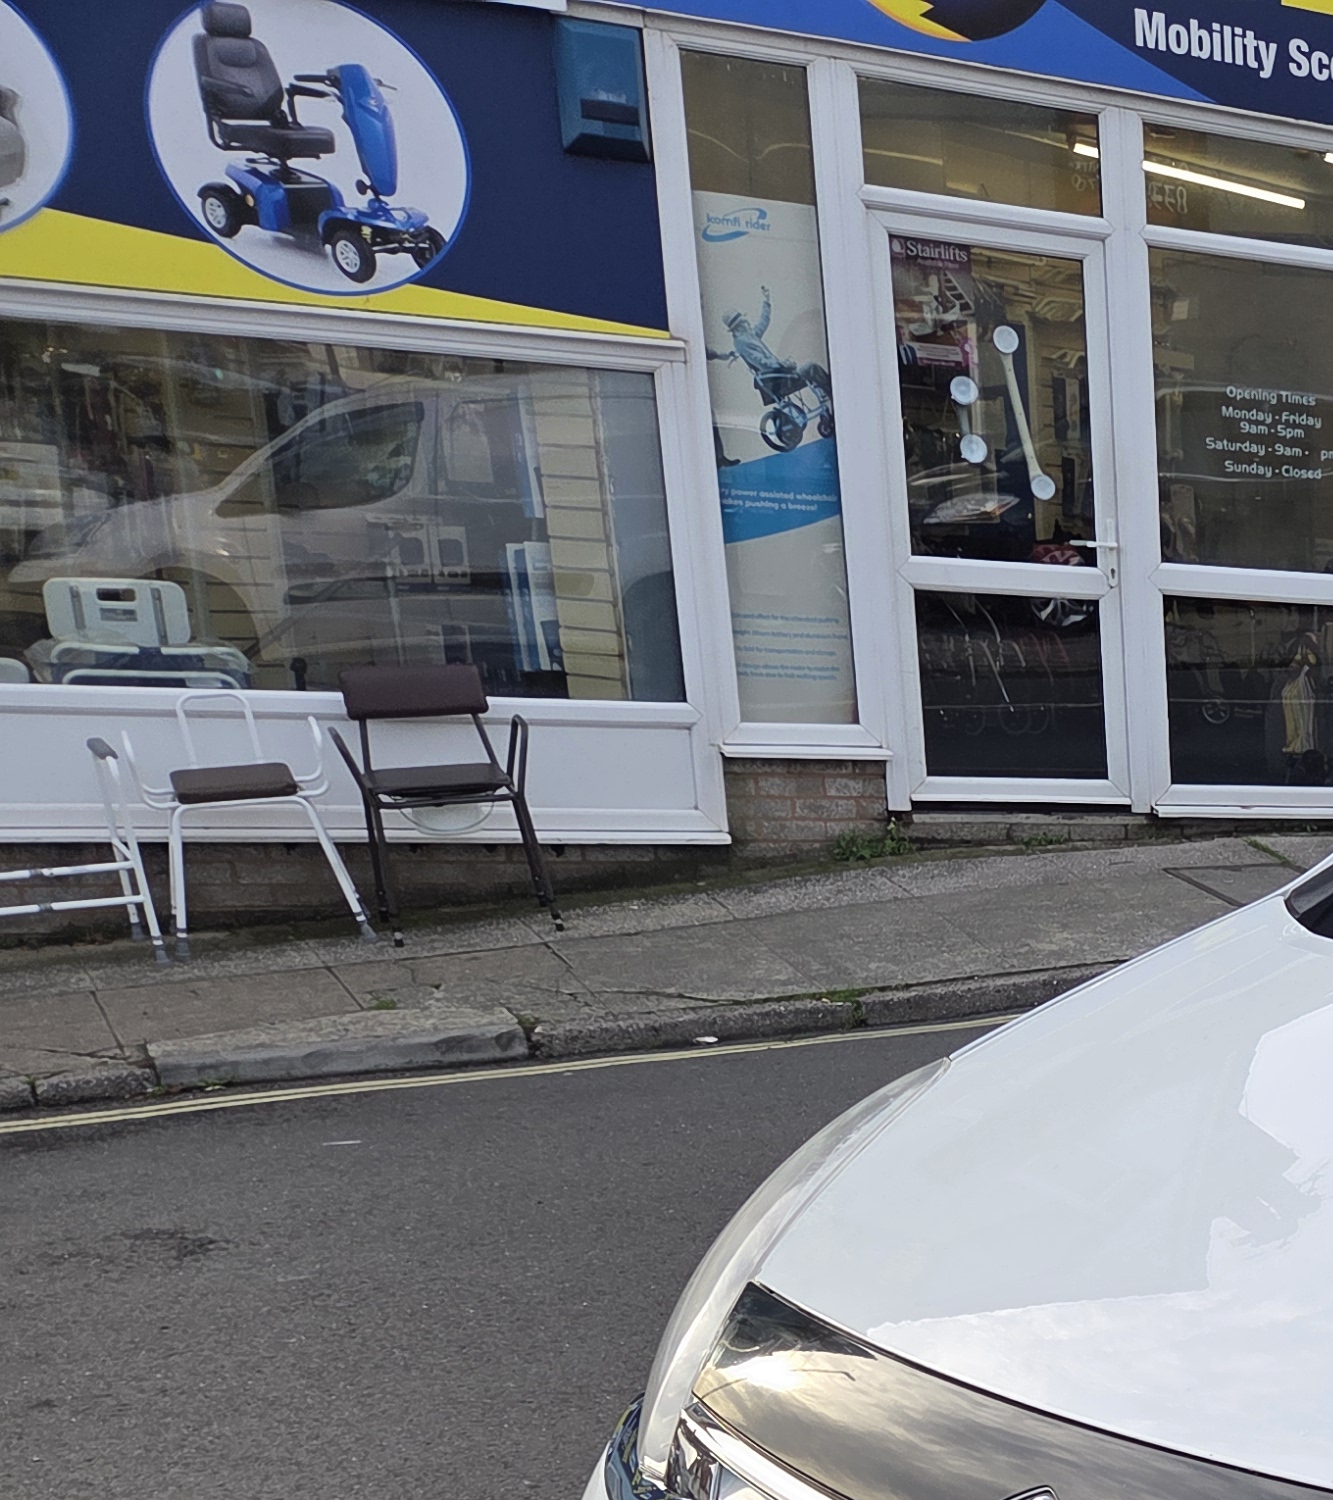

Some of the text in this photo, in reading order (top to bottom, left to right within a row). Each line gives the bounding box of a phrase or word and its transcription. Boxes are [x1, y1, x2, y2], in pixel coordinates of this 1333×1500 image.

[1133, 7, 1278, 79] Mobility
[745, 218, 771, 232] rider
[906, 240, 969, 263] Stairlifts
[1225, 385, 1317, 406] Opening Times
[1221, 405, 1273, 424] Monday
[1281, 411, 1322, 429] Friday
[1239, 421, 1269, 435] 9am
[1276, 424, 1305, 440] 5pm
[1205, 437, 1266, 457] Saturday
[1274, 443, 1303, 457] 9am
[1224, 460, 1273, 478] Sunday
[1281, 465, 1323, 480] Closed
